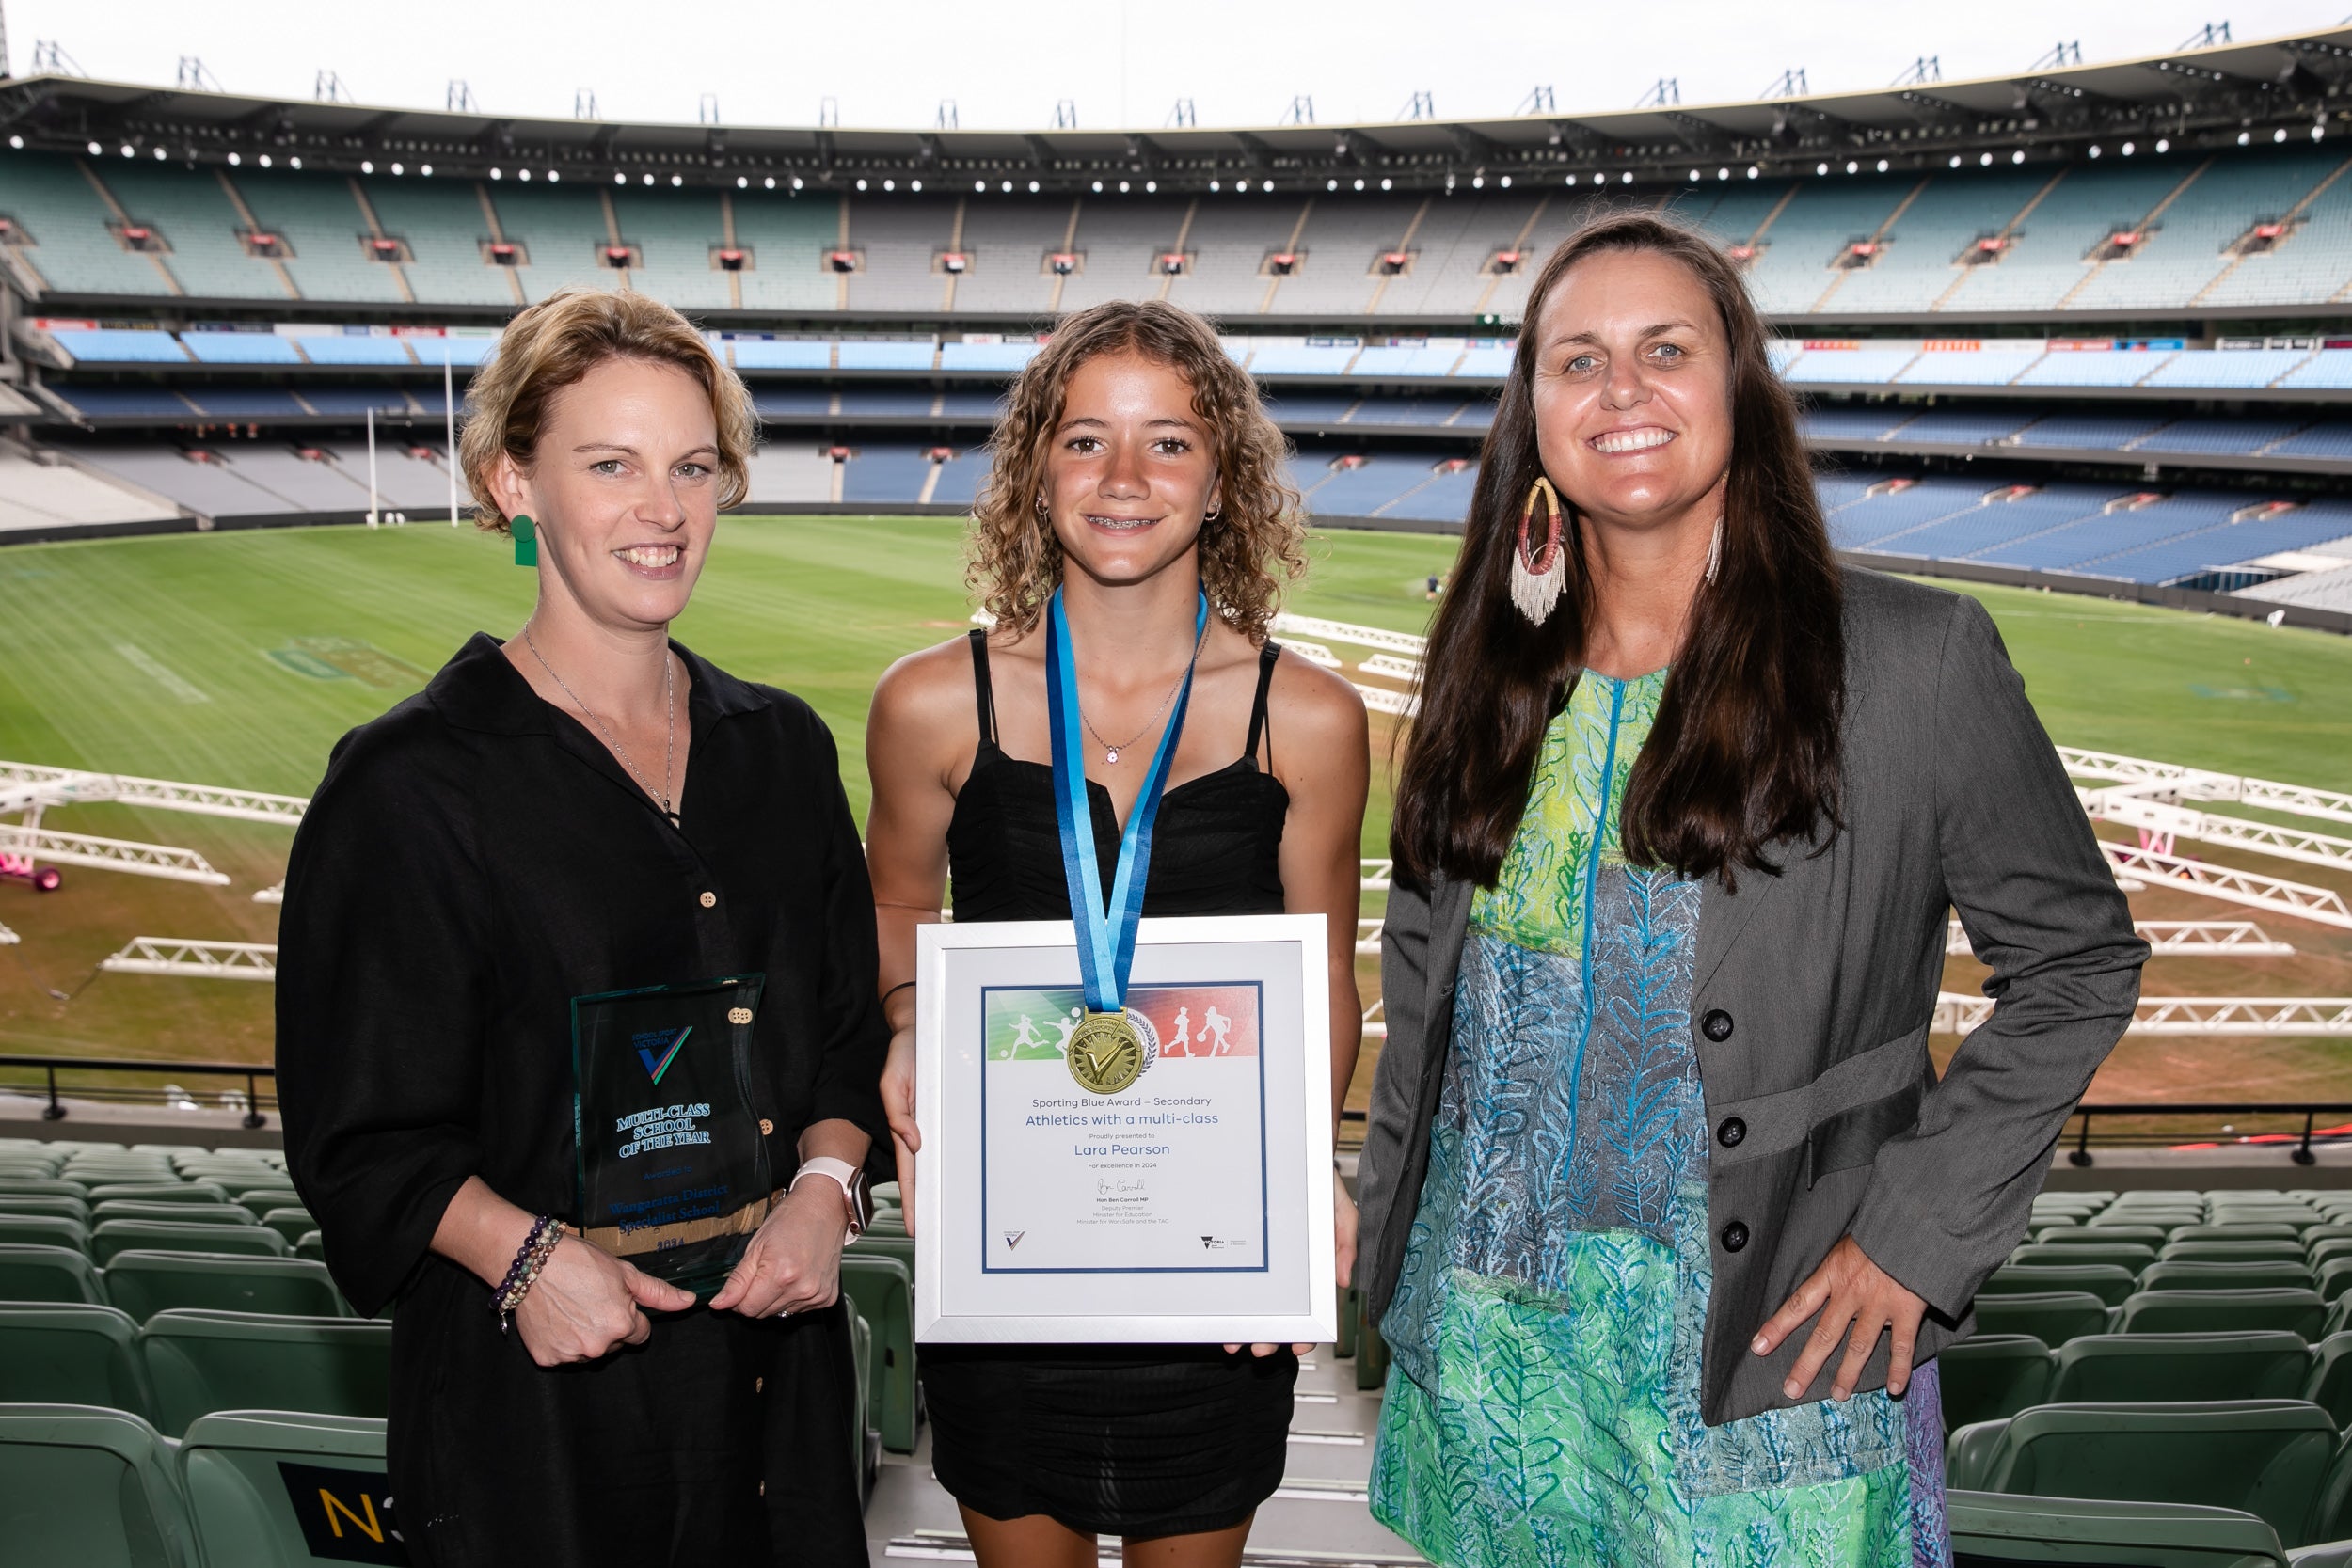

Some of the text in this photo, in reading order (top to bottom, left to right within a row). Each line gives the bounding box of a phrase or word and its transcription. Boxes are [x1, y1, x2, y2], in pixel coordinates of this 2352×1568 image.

[633, 1037, 670, 1049] VICTORIA
[1032, 1099, 1078, 1109] Sporting
[1081, 1098, 1104, 1107] Blue
[1106, 1097, 1141, 1107] Award
[1153, 1097, 1212, 1107] Secondary
[616, 1103, 710, 1132] MULTI-CLASS
[633, 1117, 696, 1140] SCHOOL
[1025, 1113, 1218, 1126] Athletics with a multi-class
[619, 1131, 711, 1158] OF THE YEAR
[1074, 1144, 1170, 1156] Lara Pearson
[607, 1184, 728, 1215] Wangaratta District
[618, 1201, 720, 1236] Specialist School
